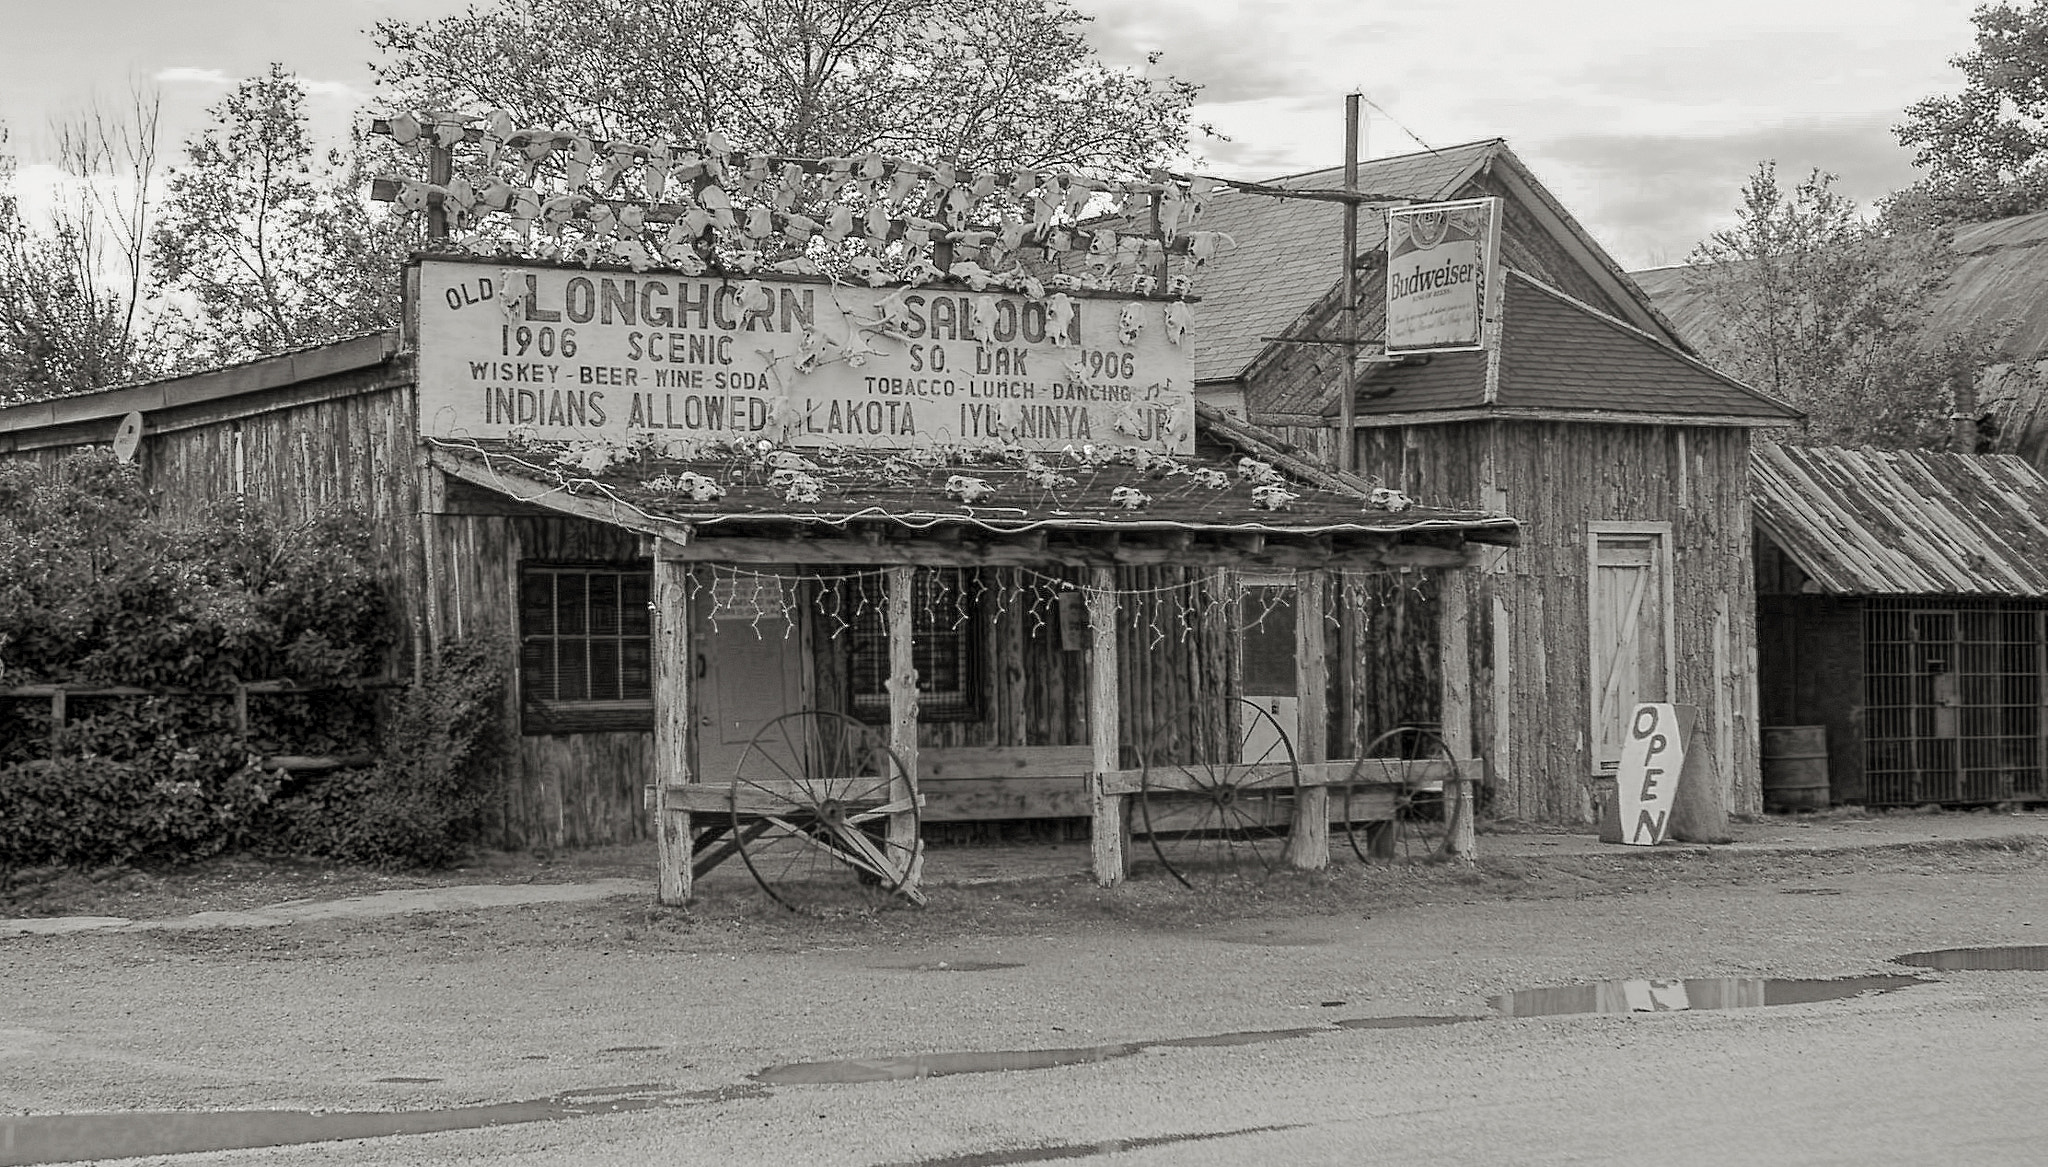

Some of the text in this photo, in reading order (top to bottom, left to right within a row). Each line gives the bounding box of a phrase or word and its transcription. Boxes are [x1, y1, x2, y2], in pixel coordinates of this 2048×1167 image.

[445, 277, 493, 311] OLD
[526, 274, 814, 333] LONGHORN
[1391, 258, 1474, 301] Budweiser
[468, 361, 559, 383] WISKEY
[502, 324, 577, 358] 1906
[627, 331, 734, 365] SCENIC
[910, 343, 951, 373] SO.
[976, 346, 1028, 376] DAK
[864, 376, 955, 397] TOBACCO
[486, 387, 607, 428] INDIANS
[628, 391, 767, 432] ALLOWED
[806, 398, 916, 436] LAKOTA
[1633, 706, 1667, 844] OPEN
